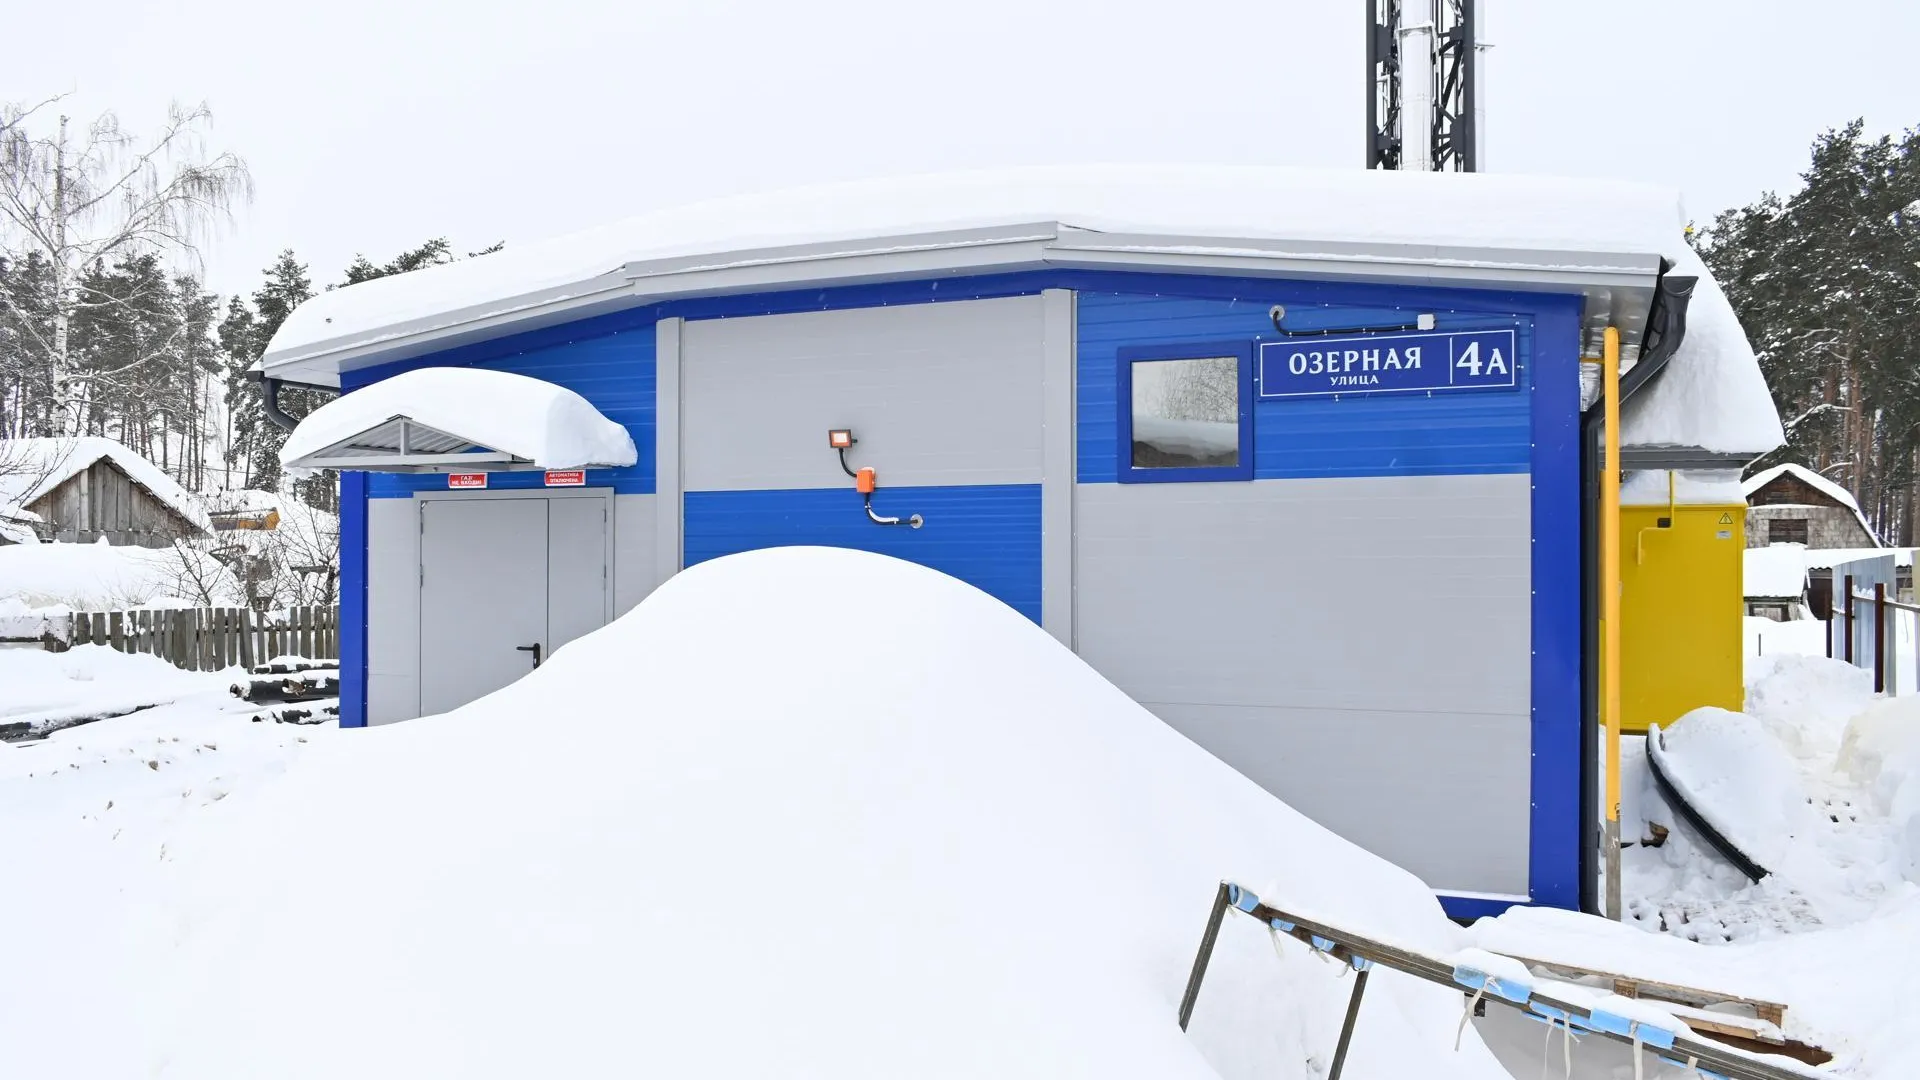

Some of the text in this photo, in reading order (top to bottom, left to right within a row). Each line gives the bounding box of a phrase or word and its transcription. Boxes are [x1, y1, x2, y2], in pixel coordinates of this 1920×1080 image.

[1288, 341, 1508, 376] ОЗЕРНАЯ 4А
[1329, 374, 1380, 386] УЛИЦА
